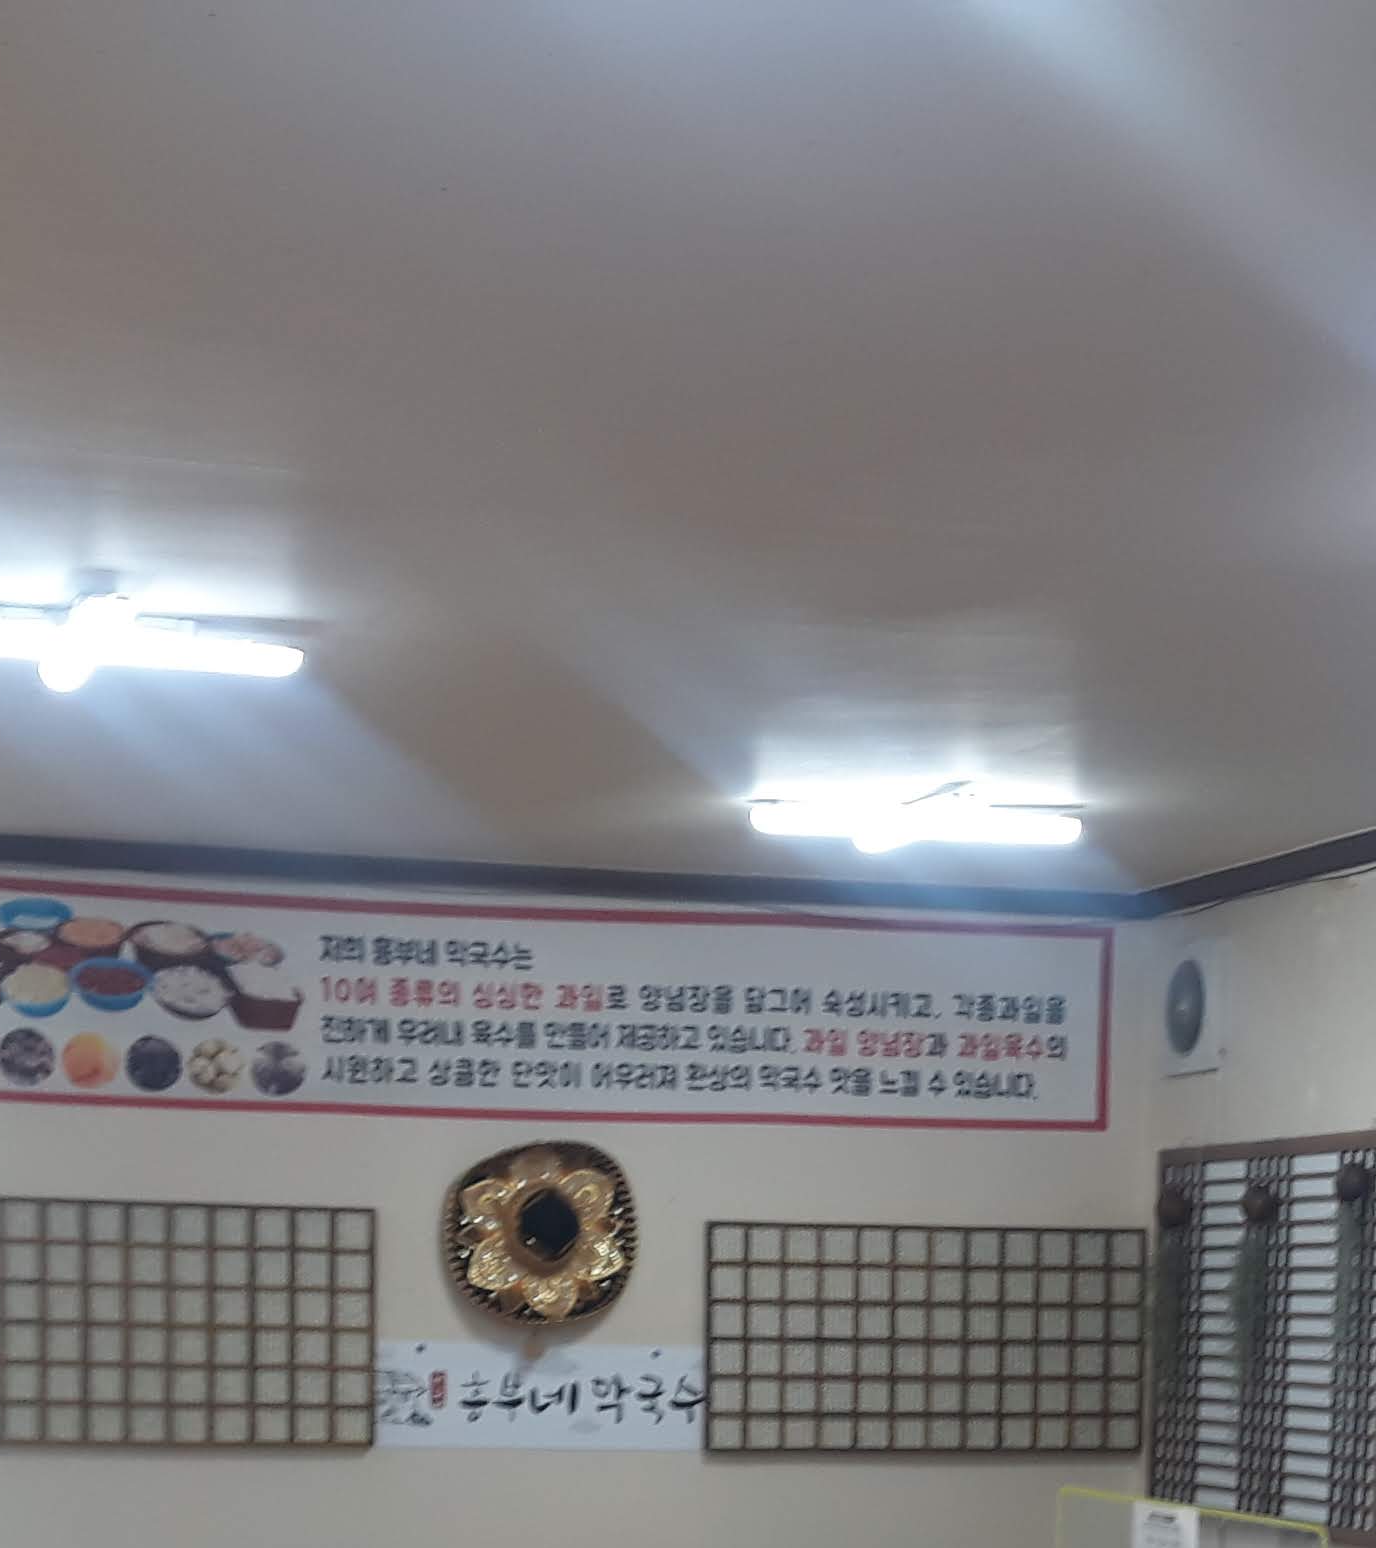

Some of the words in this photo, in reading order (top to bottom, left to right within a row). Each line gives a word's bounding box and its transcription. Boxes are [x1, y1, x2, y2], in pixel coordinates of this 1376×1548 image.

[319, 933, 367, 964] 저희
[371, 934, 438, 968] 흥부네
[445, 937, 534, 972] 막국수는
[320, 975, 378, 1004] 10여
[387, 976, 460, 1008] 종류의
[472, 979, 544, 1012] 싱싱한
[555, 982, 628, 1014] 과일로
[638, 983, 734, 1015] 양념장을
[319, 1014, 391, 1046] 진하게
[470, 1018, 538, 1051] 육수를
[542, 1019, 610, 1051] 만들어
[615, 1022, 701, 1053] 제공하고
[323, 1053, 418, 1085] 시원하고
[510, 1058, 582, 1090] 단맛이
[685, 1061, 751, 1093] 환상의
[757, 1064, 823, 1095] 막국수
[829, 1066, 873, 1098] 맛을
[878, 1069, 921, 1099] 느낄
[926, 1069, 947, 1098] 수
[458, 1370, 579, 1424] 흥부네
[590, 1371, 708, 1425] 막국수
